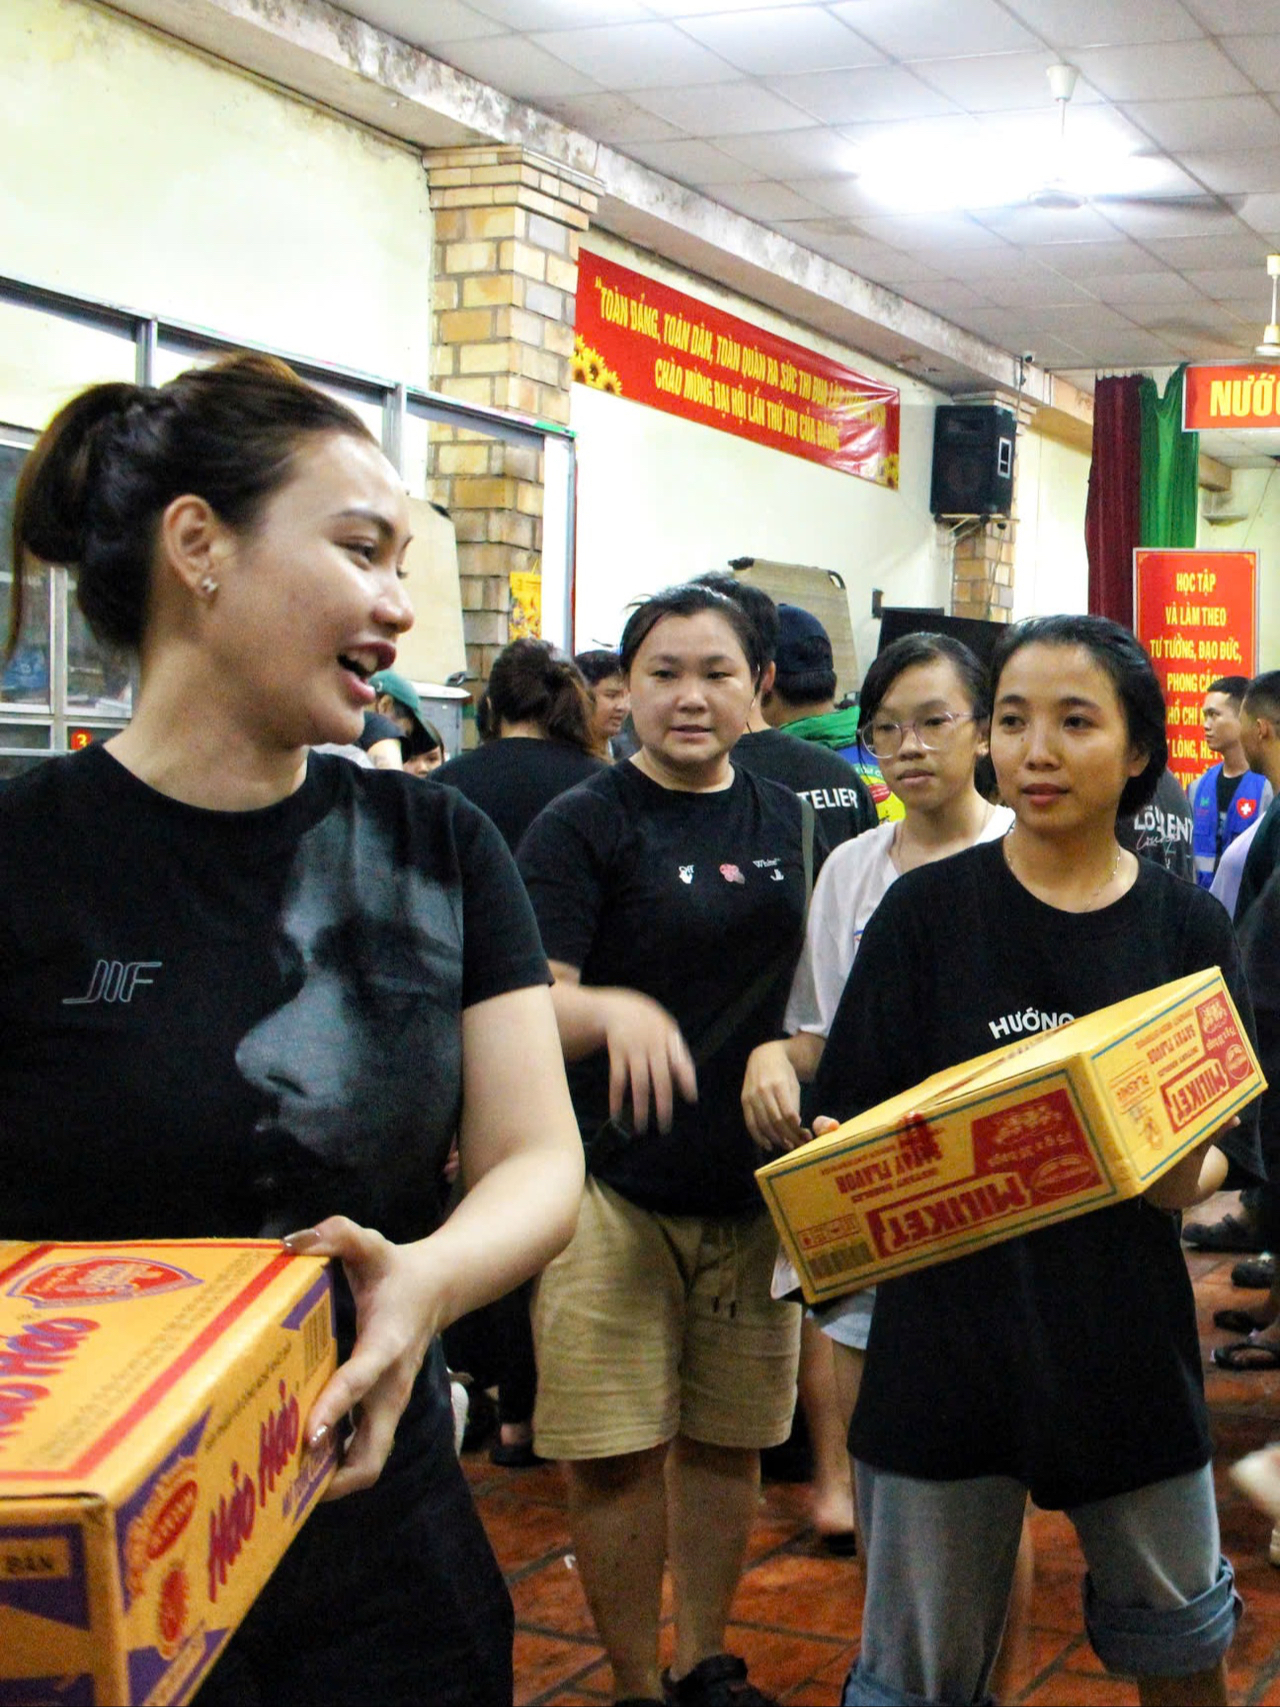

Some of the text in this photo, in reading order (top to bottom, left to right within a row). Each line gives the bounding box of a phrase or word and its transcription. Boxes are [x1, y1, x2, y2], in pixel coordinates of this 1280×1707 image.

[767, 357, 779, 387] RA
[655, 353, 682, 395] CHÀO
[684, 366, 713, 404] MỪNG
[714, 380, 730, 418] ĐẠI
[731, 385, 745, 425] HỘI
[1176, 568, 1216, 596] HỌC TẬP
[1165, 601, 1227, 626] VÀ LÀM THEO
[1150, 637, 1163, 659] TƯ
[1163, 632, 1197, 662] TƯỞNG,
[1198, 640, 1217, 663] ĐẠO
[1167, 673, 1197, 692] PHONG
[1182, 704, 1197, 725] CHÍ
[1172, 735, 1198, 761] LÒNG,
[796, 787, 859, 809] TELIER
[1169, 1060, 1228, 1125] MILIKET
[885, 1174, 1029, 1250] MILIKET
[207, 1461, 257, 1604] Hảo
[259, 1379, 299, 1508] Hảo
